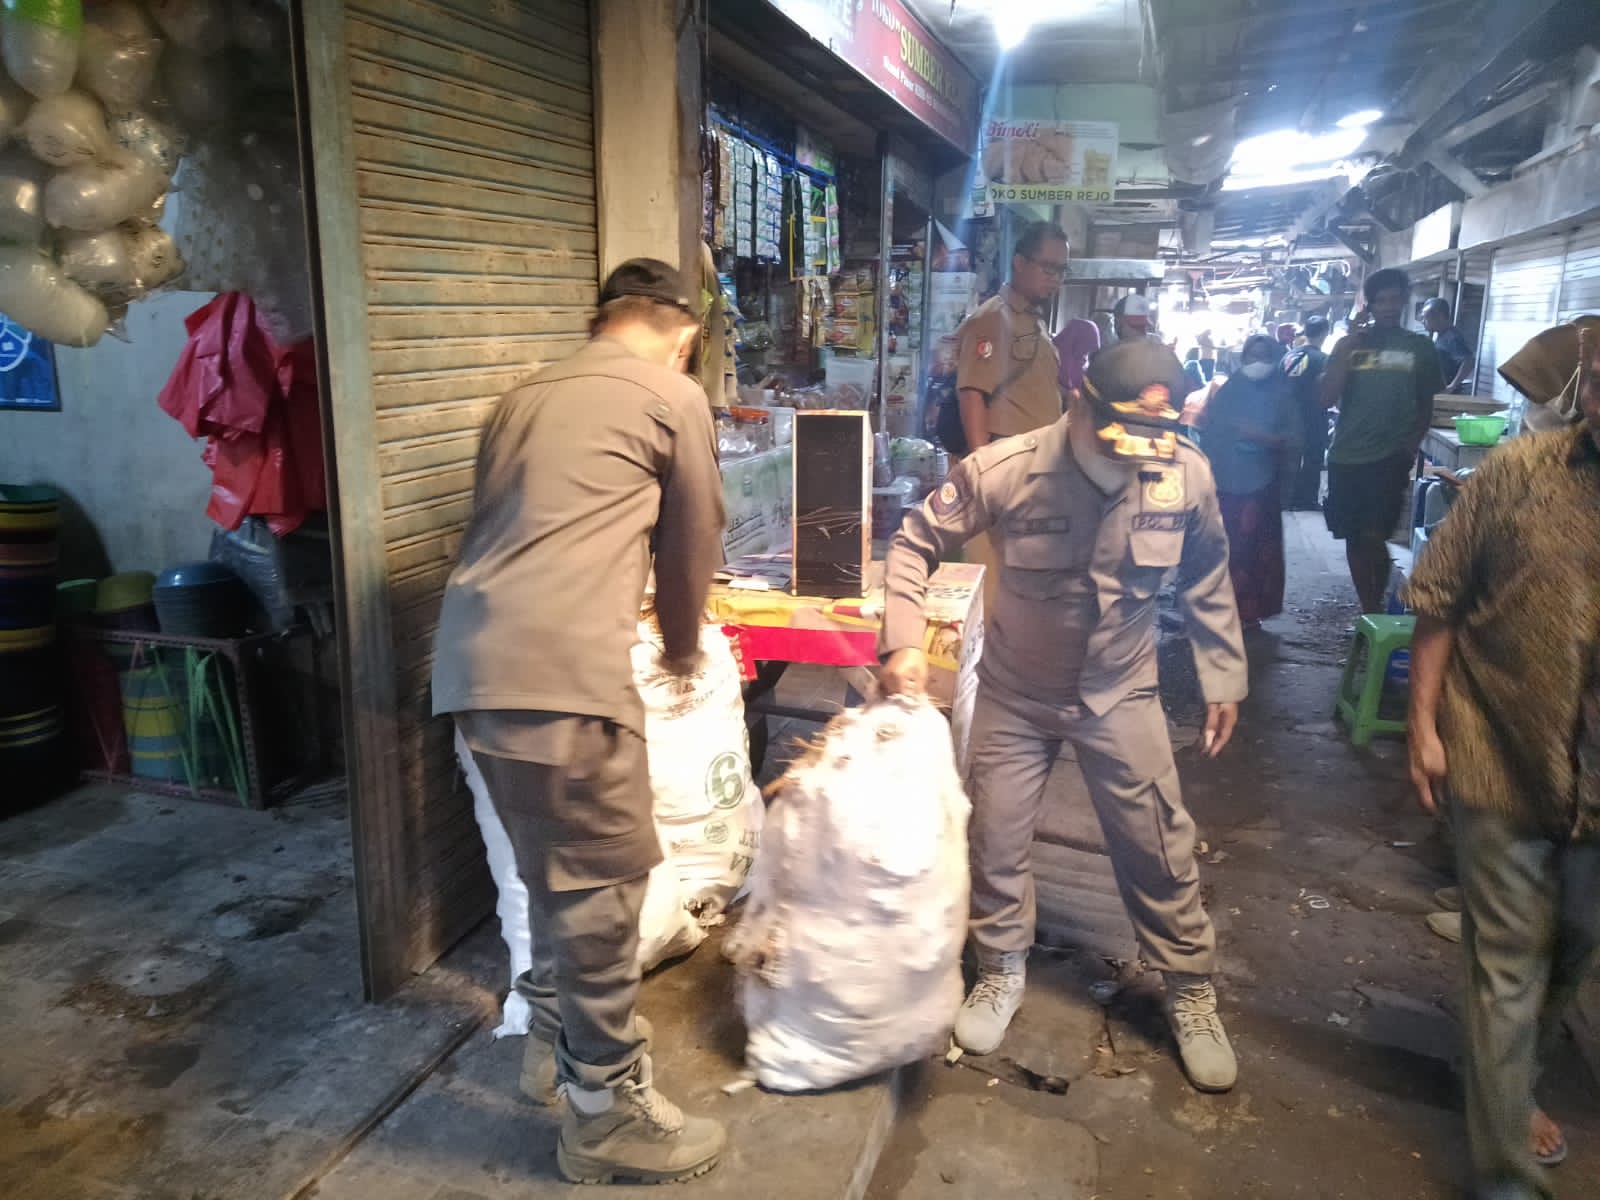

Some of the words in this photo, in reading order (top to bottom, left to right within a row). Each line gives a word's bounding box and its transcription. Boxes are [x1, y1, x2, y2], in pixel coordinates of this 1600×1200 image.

[991, 189, 1015, 200] OKO
[1020, 189, 1072, 201] SUMBER
[1077, 191, 1110, 201] REJO
